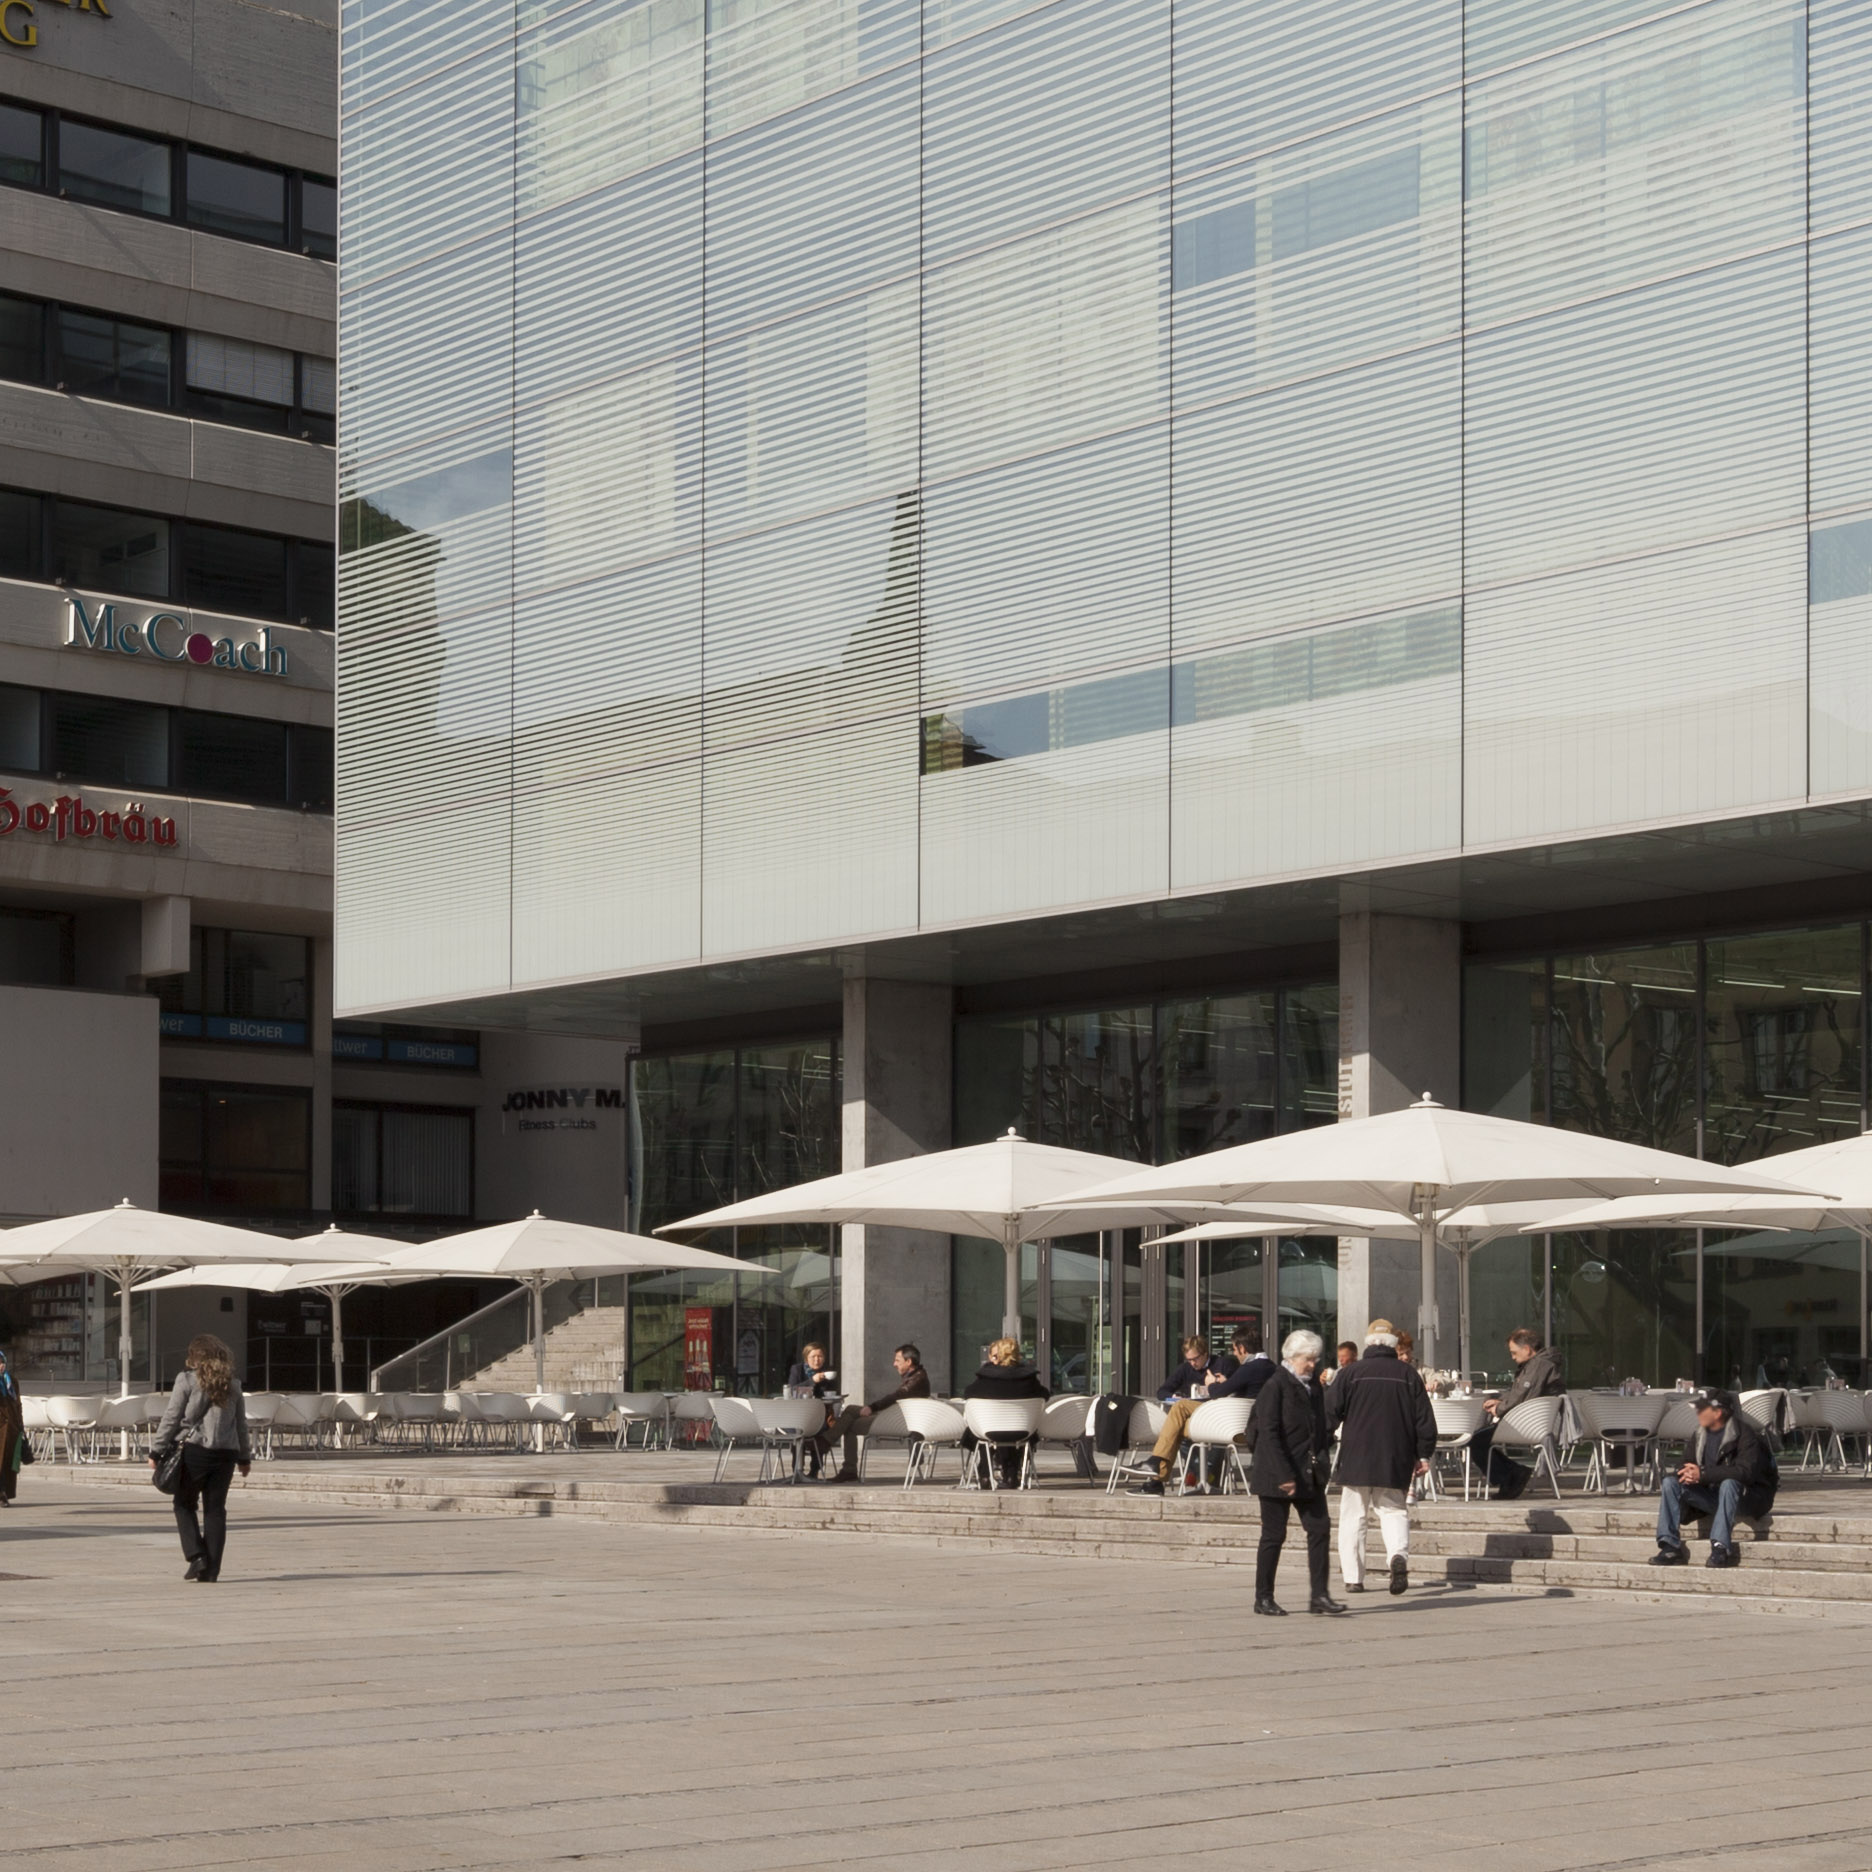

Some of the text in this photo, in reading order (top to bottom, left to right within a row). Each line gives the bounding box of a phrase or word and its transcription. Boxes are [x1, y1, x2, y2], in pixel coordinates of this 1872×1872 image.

[229, 1019, 283, 1039] BÜCHER
[406, 1044, 456, 1061] BÜCHER
[502, 1088, 626, 1111] JONNY M.
